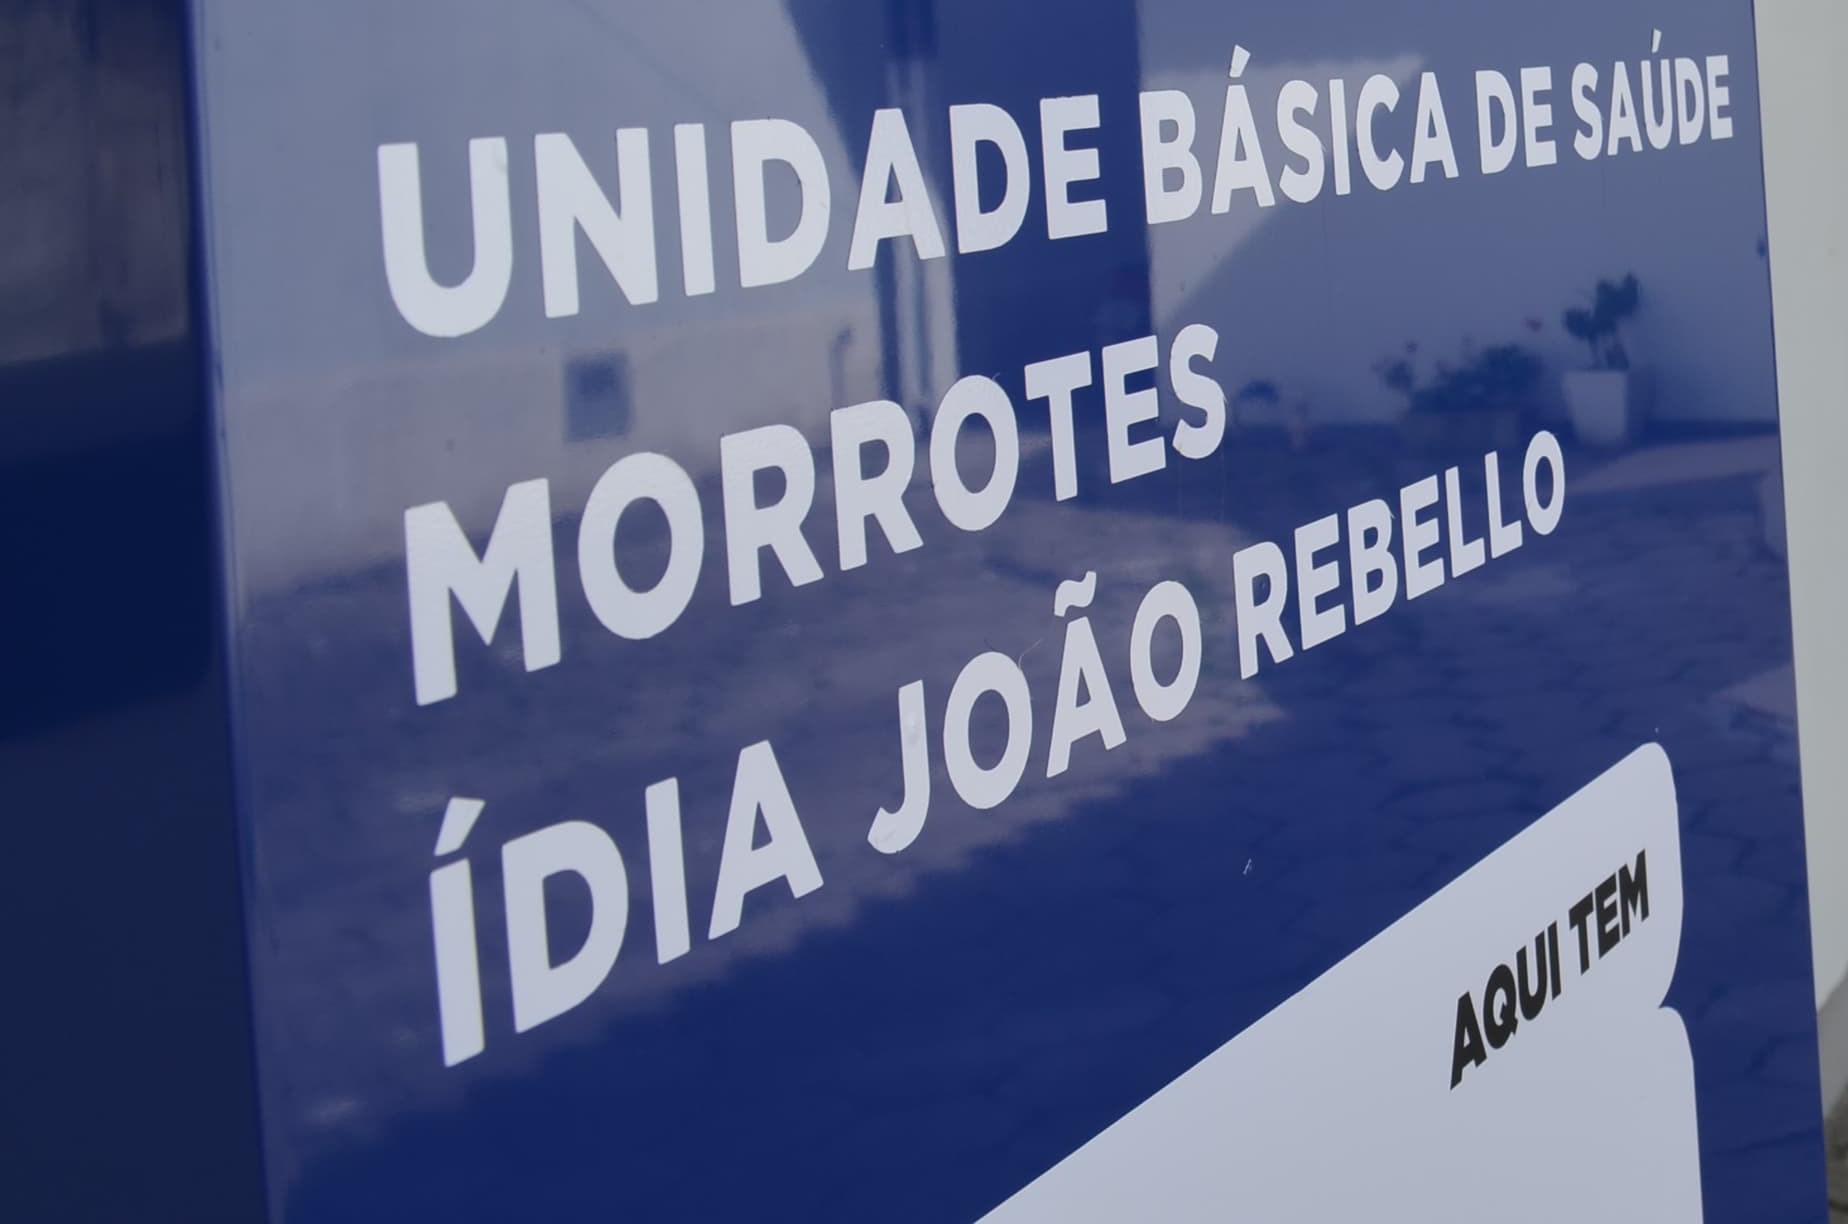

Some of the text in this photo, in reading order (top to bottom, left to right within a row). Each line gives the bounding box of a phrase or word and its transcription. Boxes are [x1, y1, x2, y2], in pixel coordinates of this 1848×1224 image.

[378, 29, 1734, 338] UNIDADE BÁSICA DE SAÚDE
[402, 323, 1226, 706] MORROTES
[429, 430, 1566, 1067] ÍDIA JOÃO REBELLO
[1450, 850, 1650, 1089] AQUI TEM
